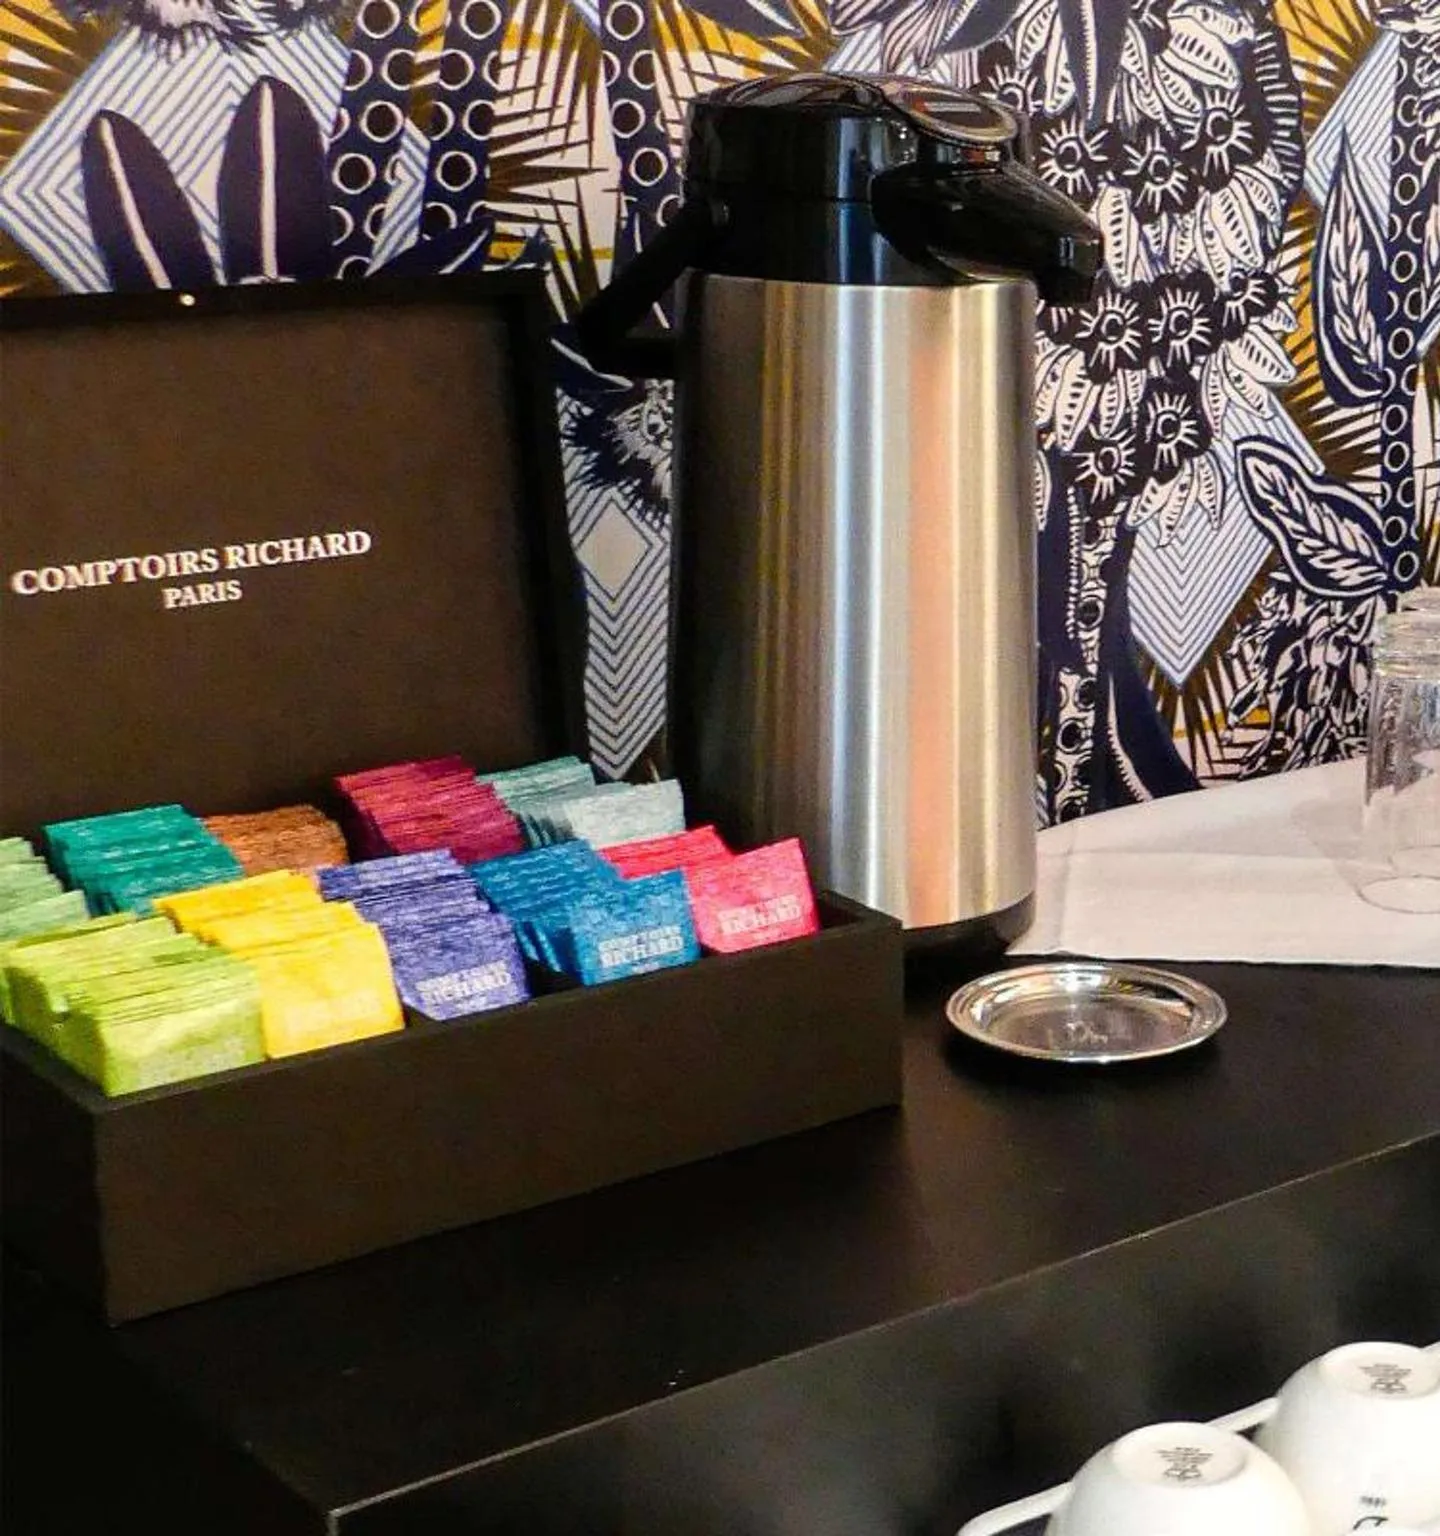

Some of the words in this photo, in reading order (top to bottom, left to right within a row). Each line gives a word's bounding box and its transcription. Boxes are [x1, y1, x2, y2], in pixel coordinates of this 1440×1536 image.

[11, 547, 220, 596] COMPTOIRS
[224, 530, 373, 571] RICHARD
[162, 579, 243, 609] PARIS
